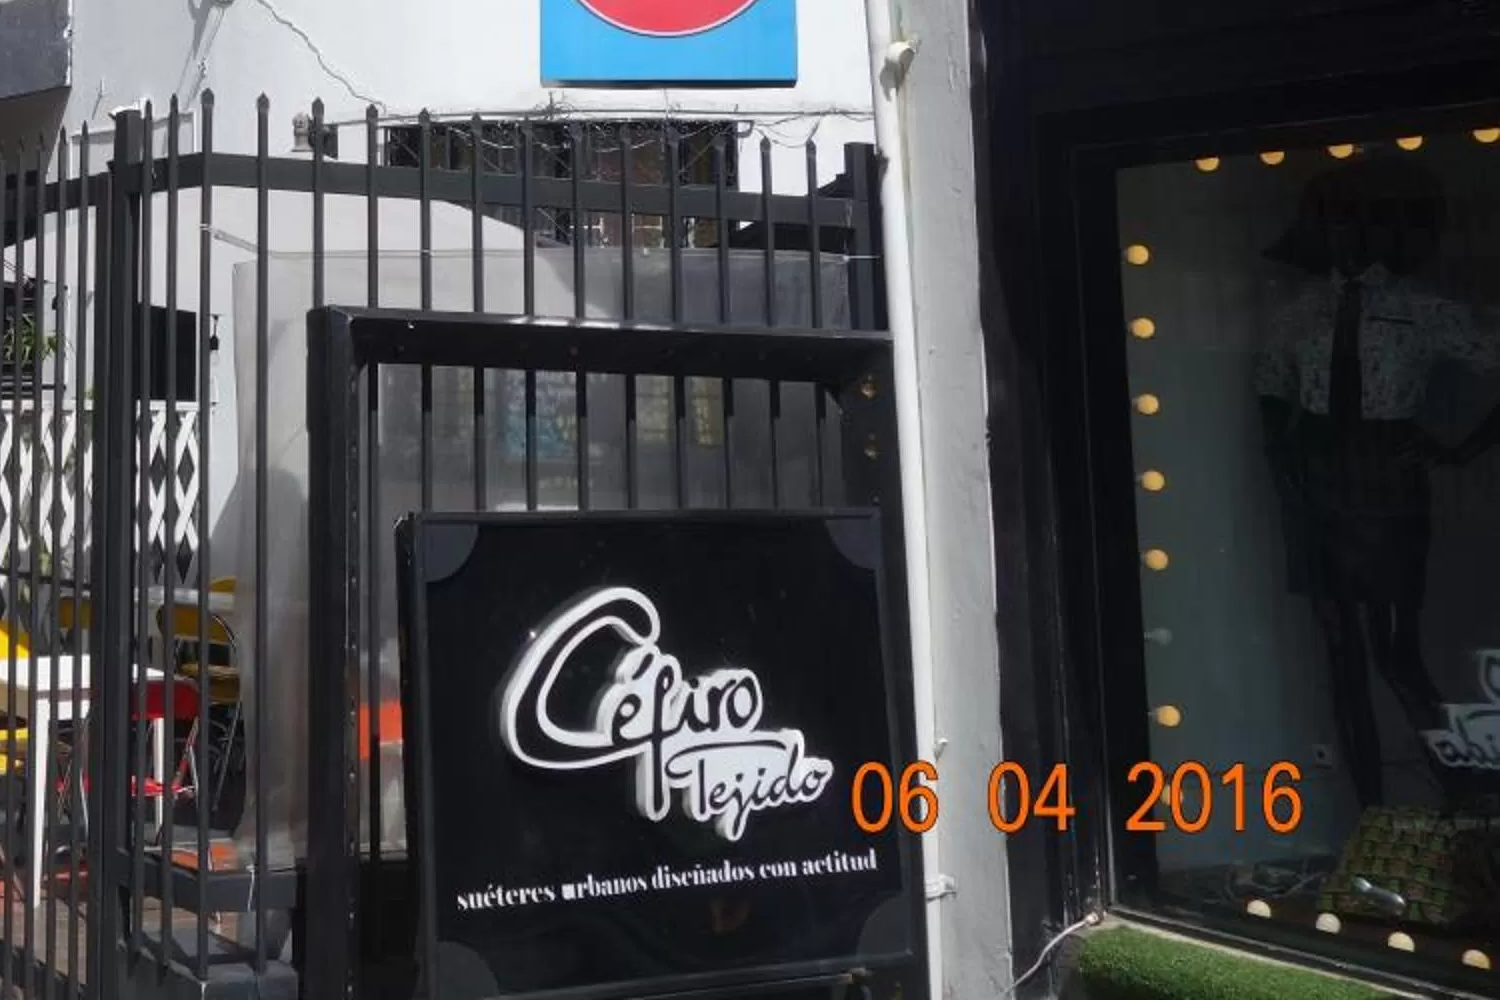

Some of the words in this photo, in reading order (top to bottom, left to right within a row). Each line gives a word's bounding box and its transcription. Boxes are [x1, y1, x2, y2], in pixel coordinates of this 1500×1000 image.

[507, 587, 763, 821] Céfiro
[663, 733, 833, 840] Tejido
[456, 883, 556, 912] suéteres
[561, 874, 648, 901] urbanos
[650, 860, 756, 891] diseñados
[759, 858, 798, 879] con
[801, 848, 879, 876] actitud
